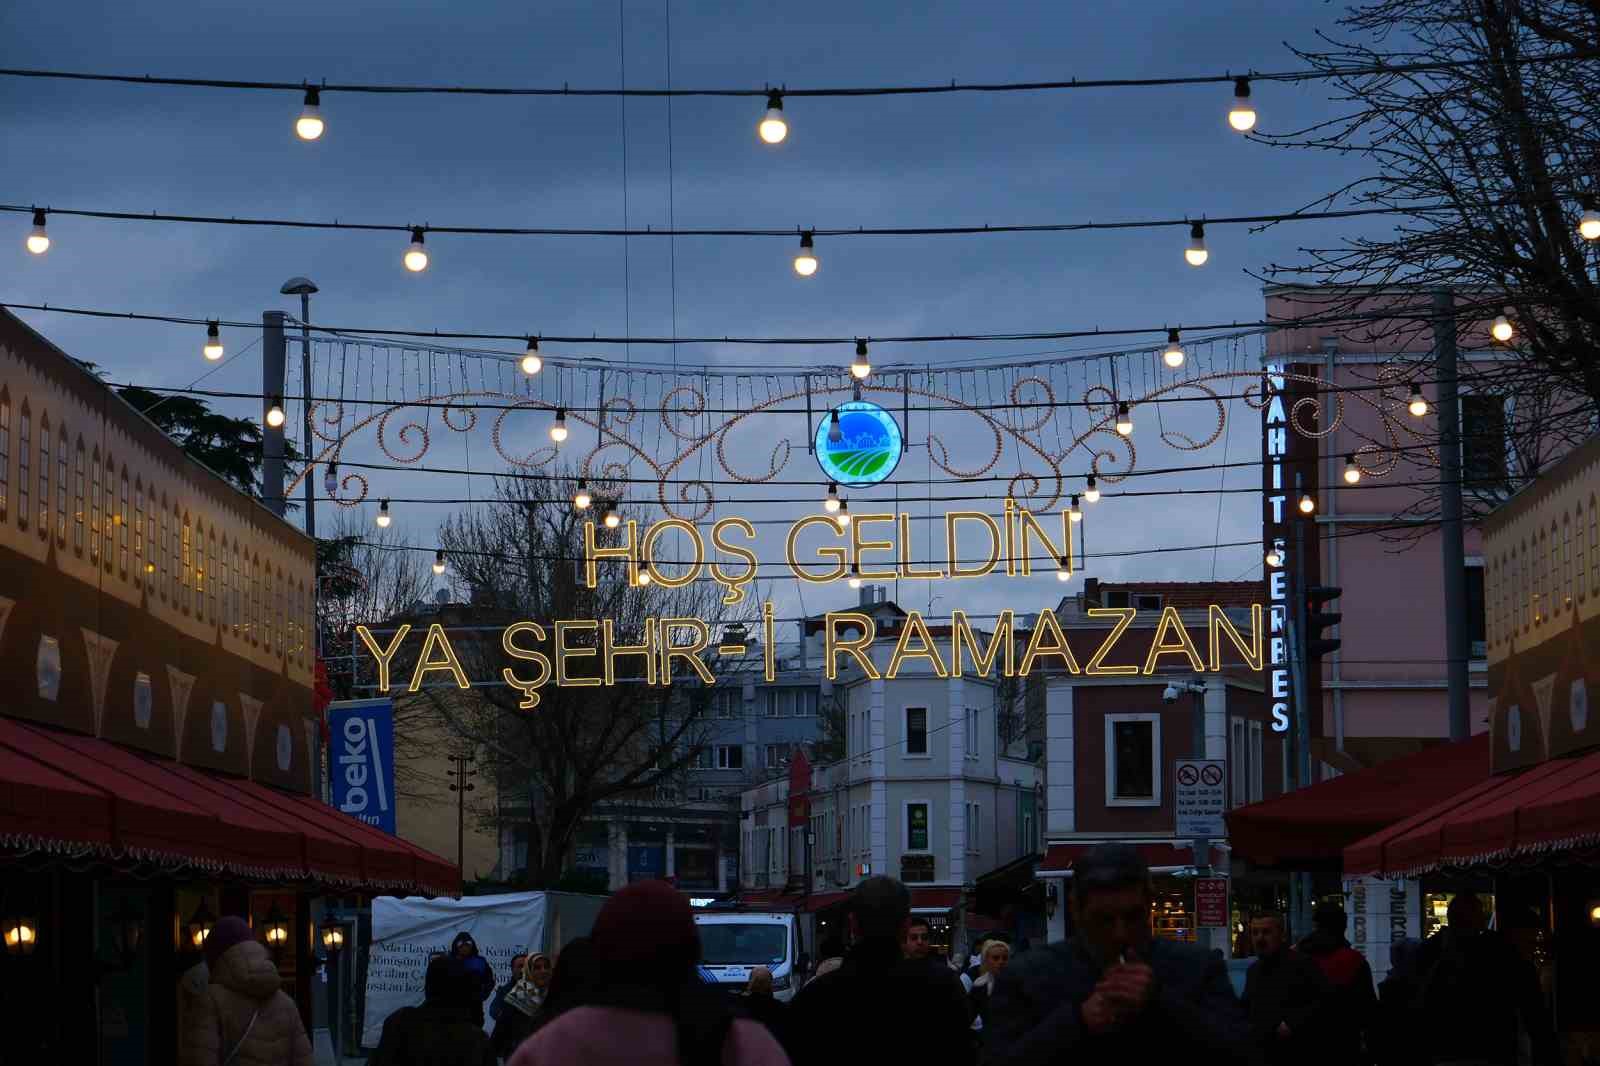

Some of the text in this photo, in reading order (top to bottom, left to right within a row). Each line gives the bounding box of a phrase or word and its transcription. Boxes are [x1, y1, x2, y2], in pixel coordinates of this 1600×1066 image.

[583, 498, 1075, 605] HOŞ GELDİN
[356, 622, 471, 693] YA
[824, 603, 1264, 681] RAMAZAN
[339, 717, 369, 813] beko
